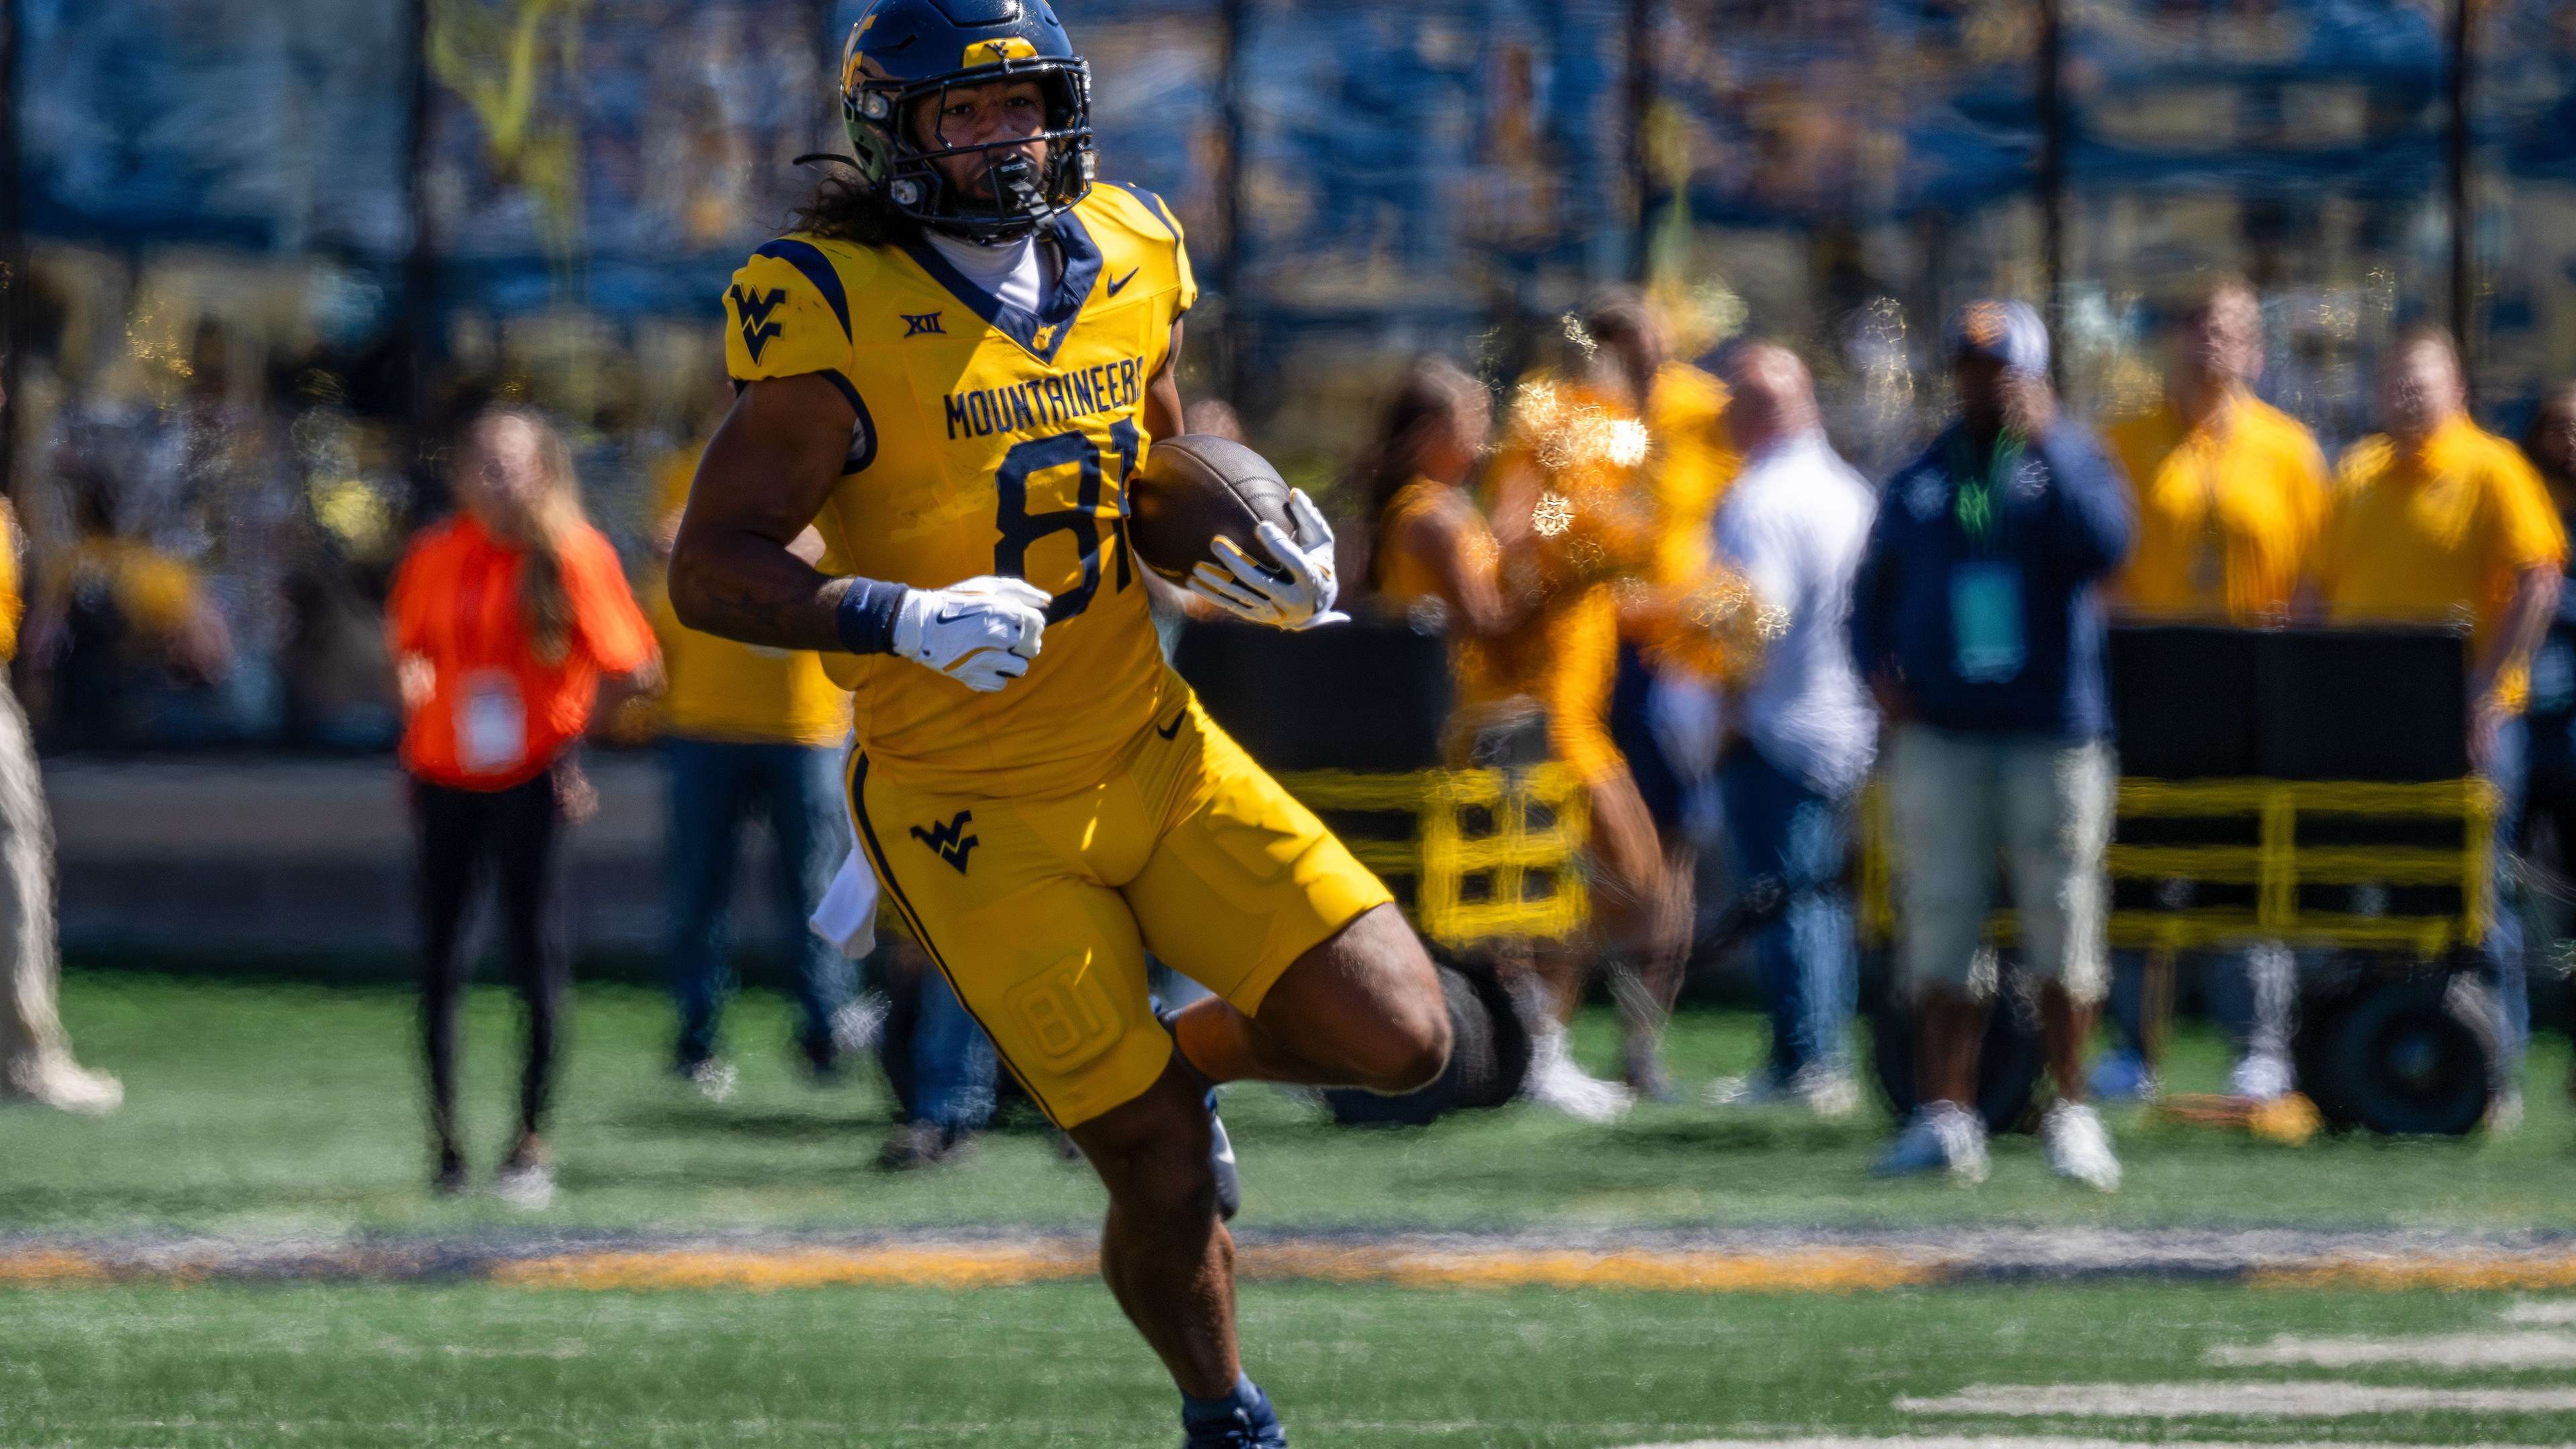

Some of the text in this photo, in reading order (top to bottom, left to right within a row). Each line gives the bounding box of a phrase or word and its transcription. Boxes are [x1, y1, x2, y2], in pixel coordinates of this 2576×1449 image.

[899, 311, 947, 338] XII
[994, 414, 1139, 627] 81
[1020, 971, 1102, 1058] 81
